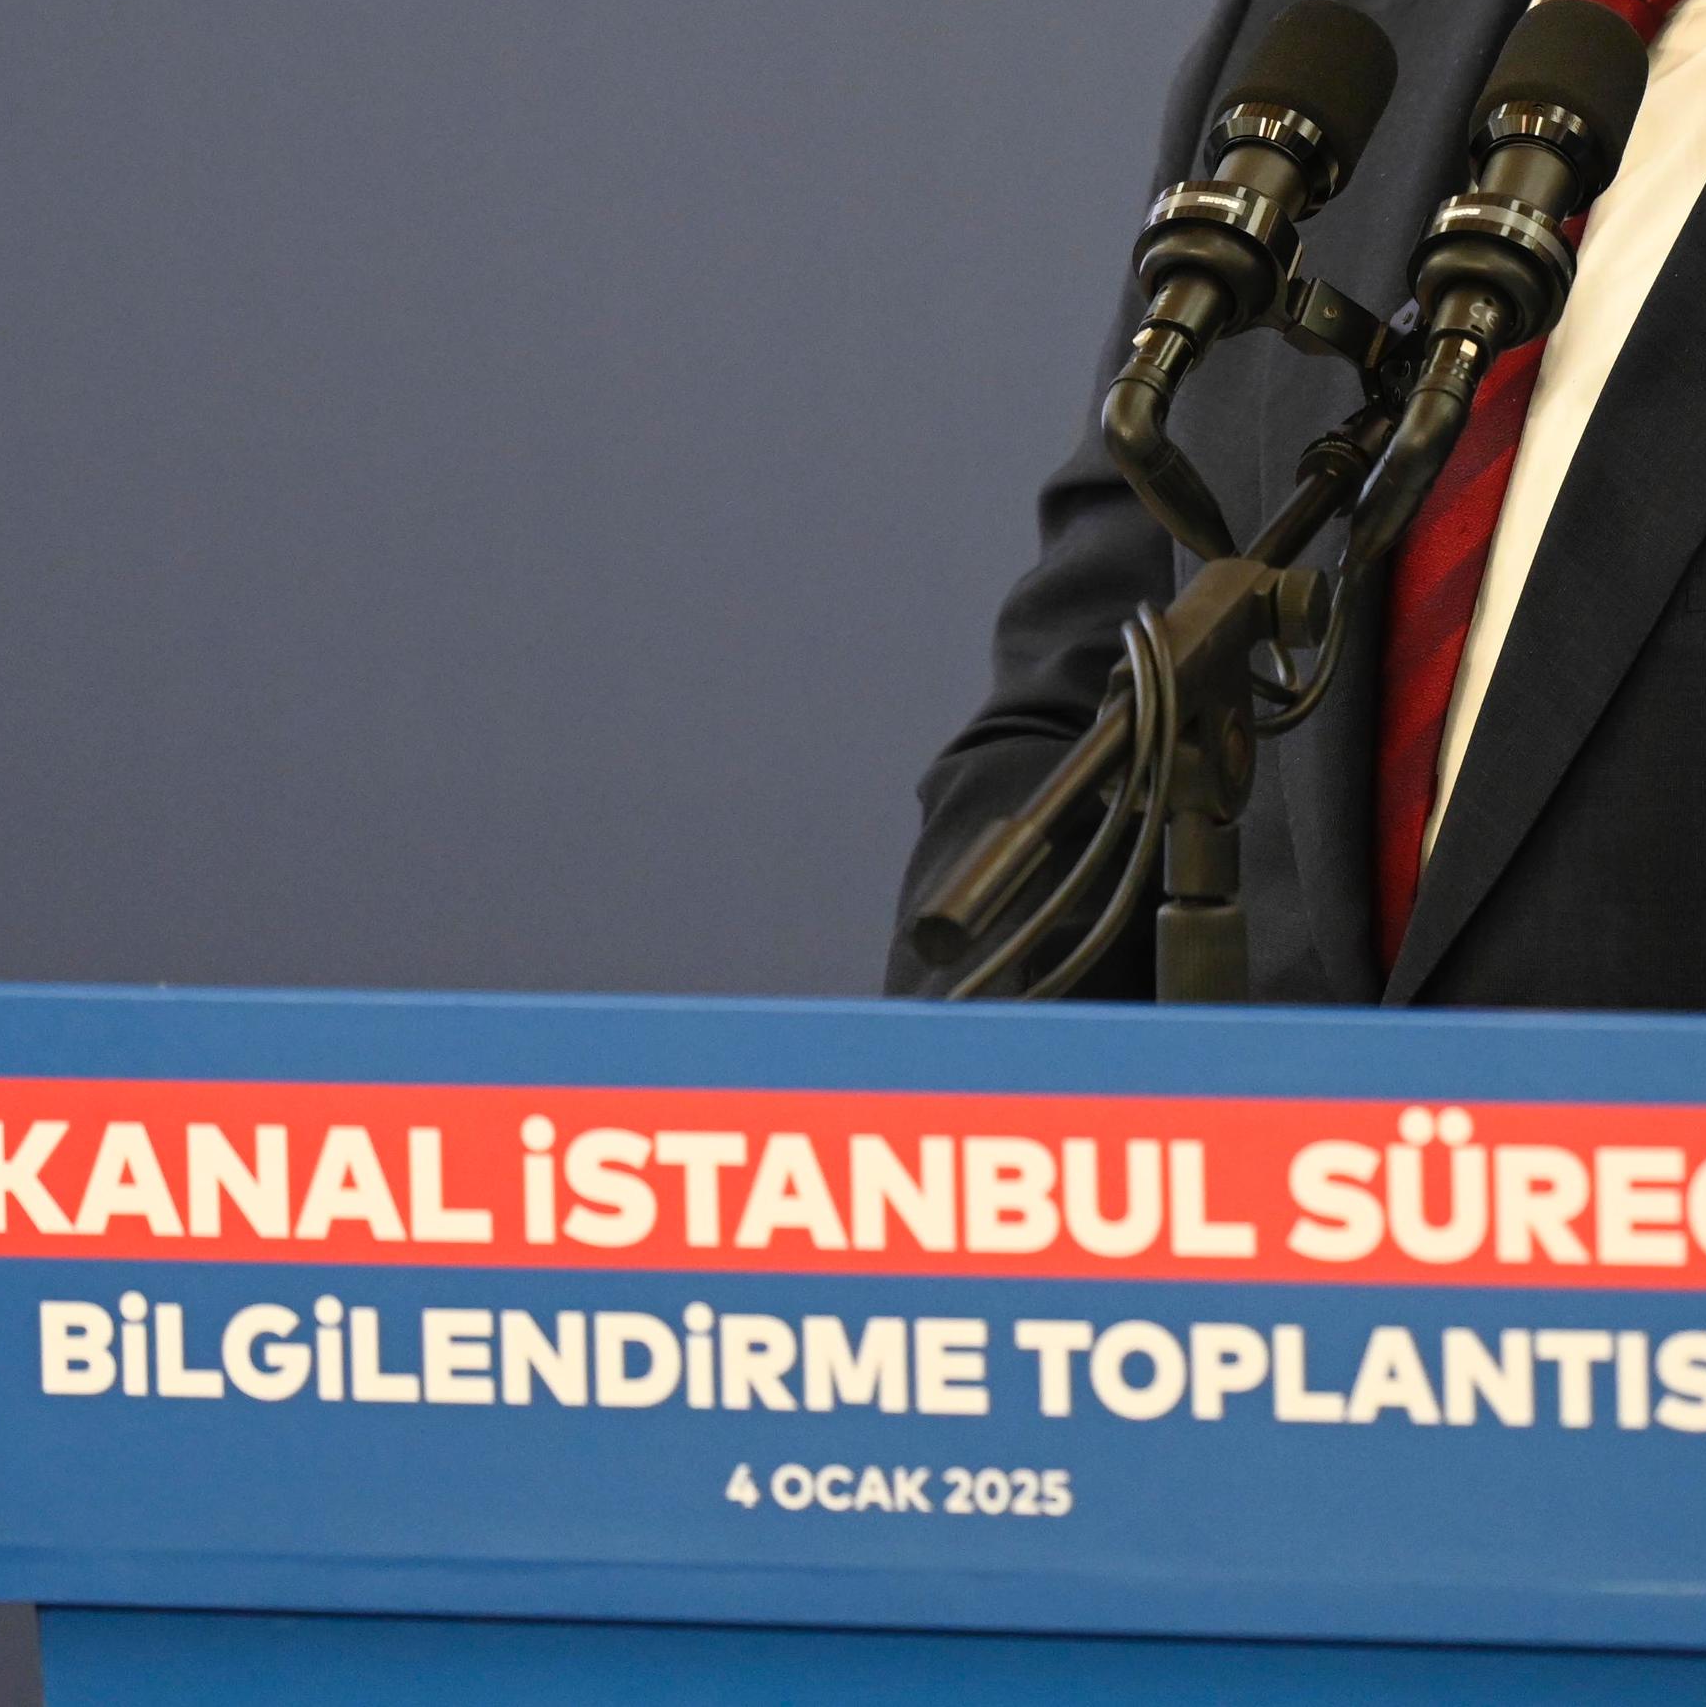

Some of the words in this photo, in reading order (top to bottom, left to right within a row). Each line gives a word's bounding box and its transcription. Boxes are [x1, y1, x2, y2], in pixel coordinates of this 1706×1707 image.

[724, 1463, 760, 1509] 4
[770, 1463, 933, 1513] OCAK
[942, 1466, 1073, 1517] 2025
